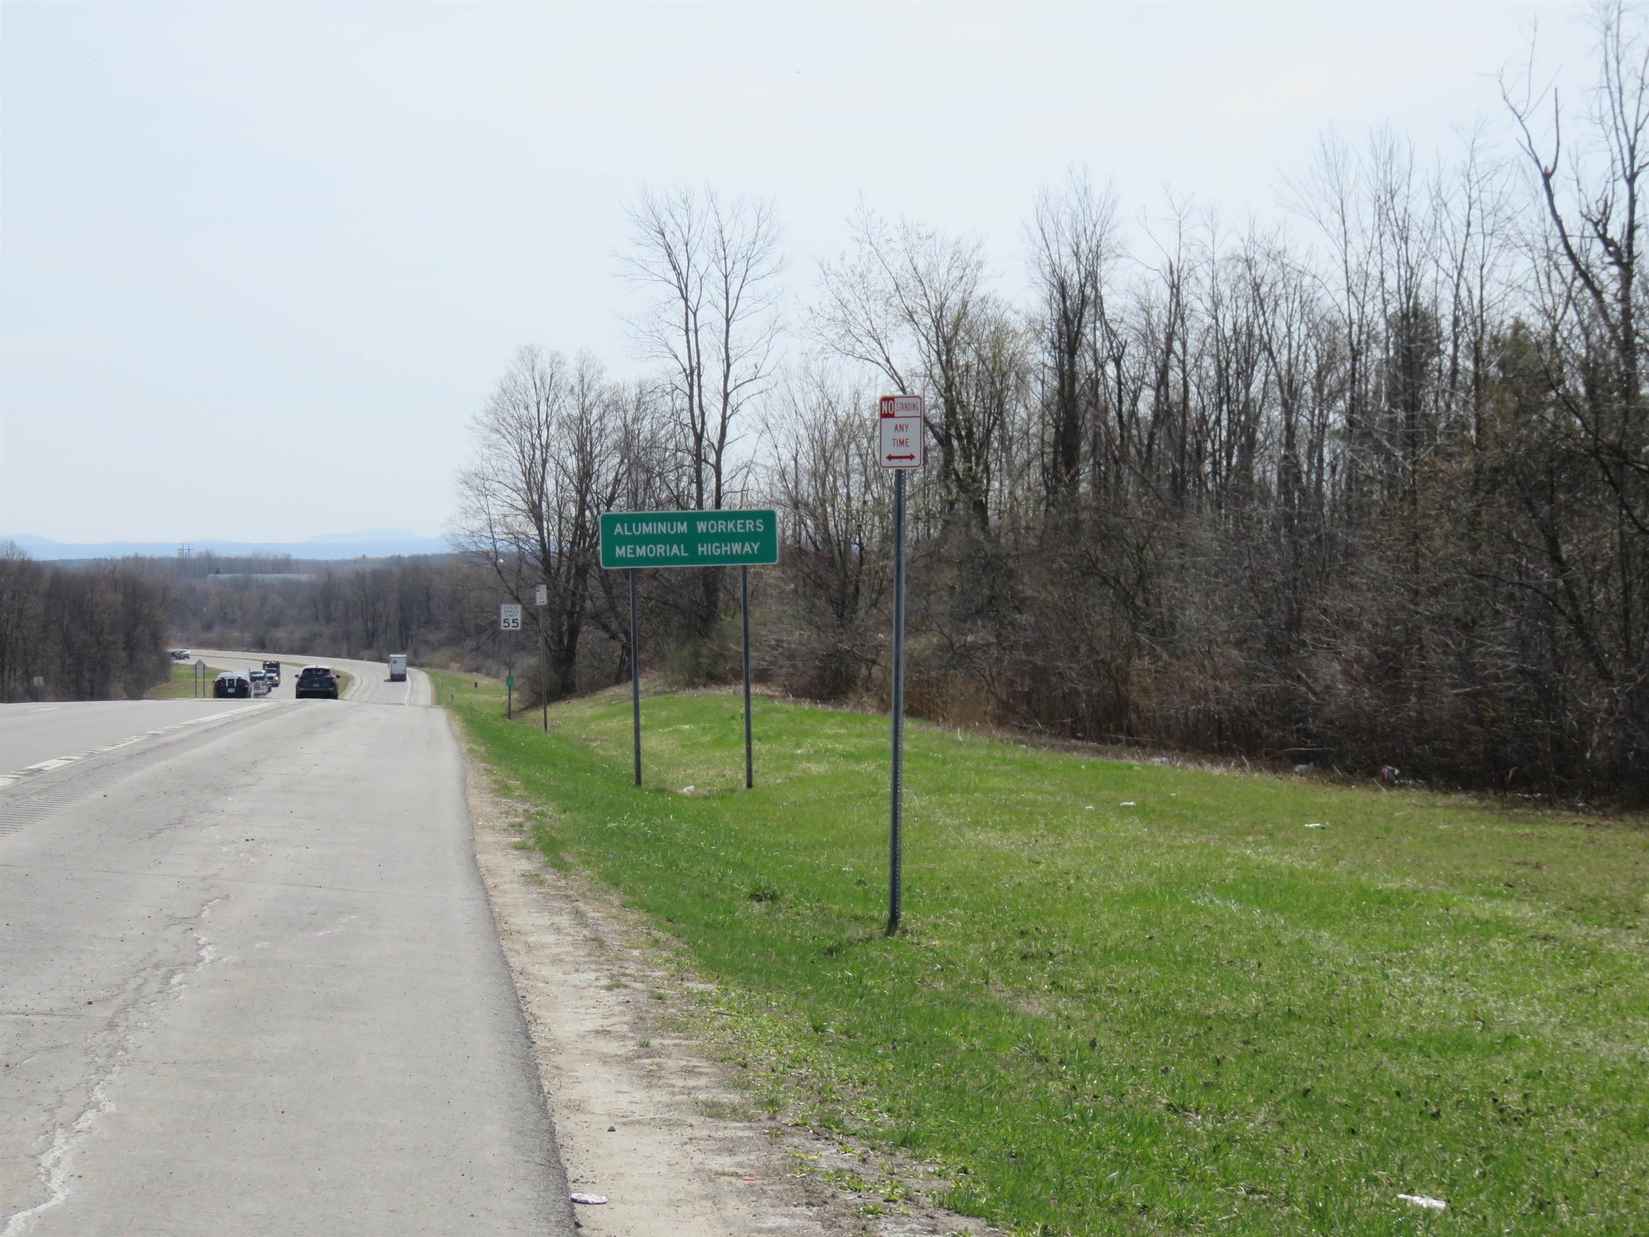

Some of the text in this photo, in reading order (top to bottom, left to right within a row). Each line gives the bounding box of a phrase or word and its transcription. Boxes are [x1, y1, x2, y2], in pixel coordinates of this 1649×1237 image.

[881, 400, 894, 415] NO
[894, 423, 909, 433] ANY
[892, 438, 910, 448] TIME
[614, 519, 765, 536] ALUMINUM WORKERS
[615, 542, 760, 558] MEMORIAL HIGHWAY
[503, 618, 520, 628] 55
